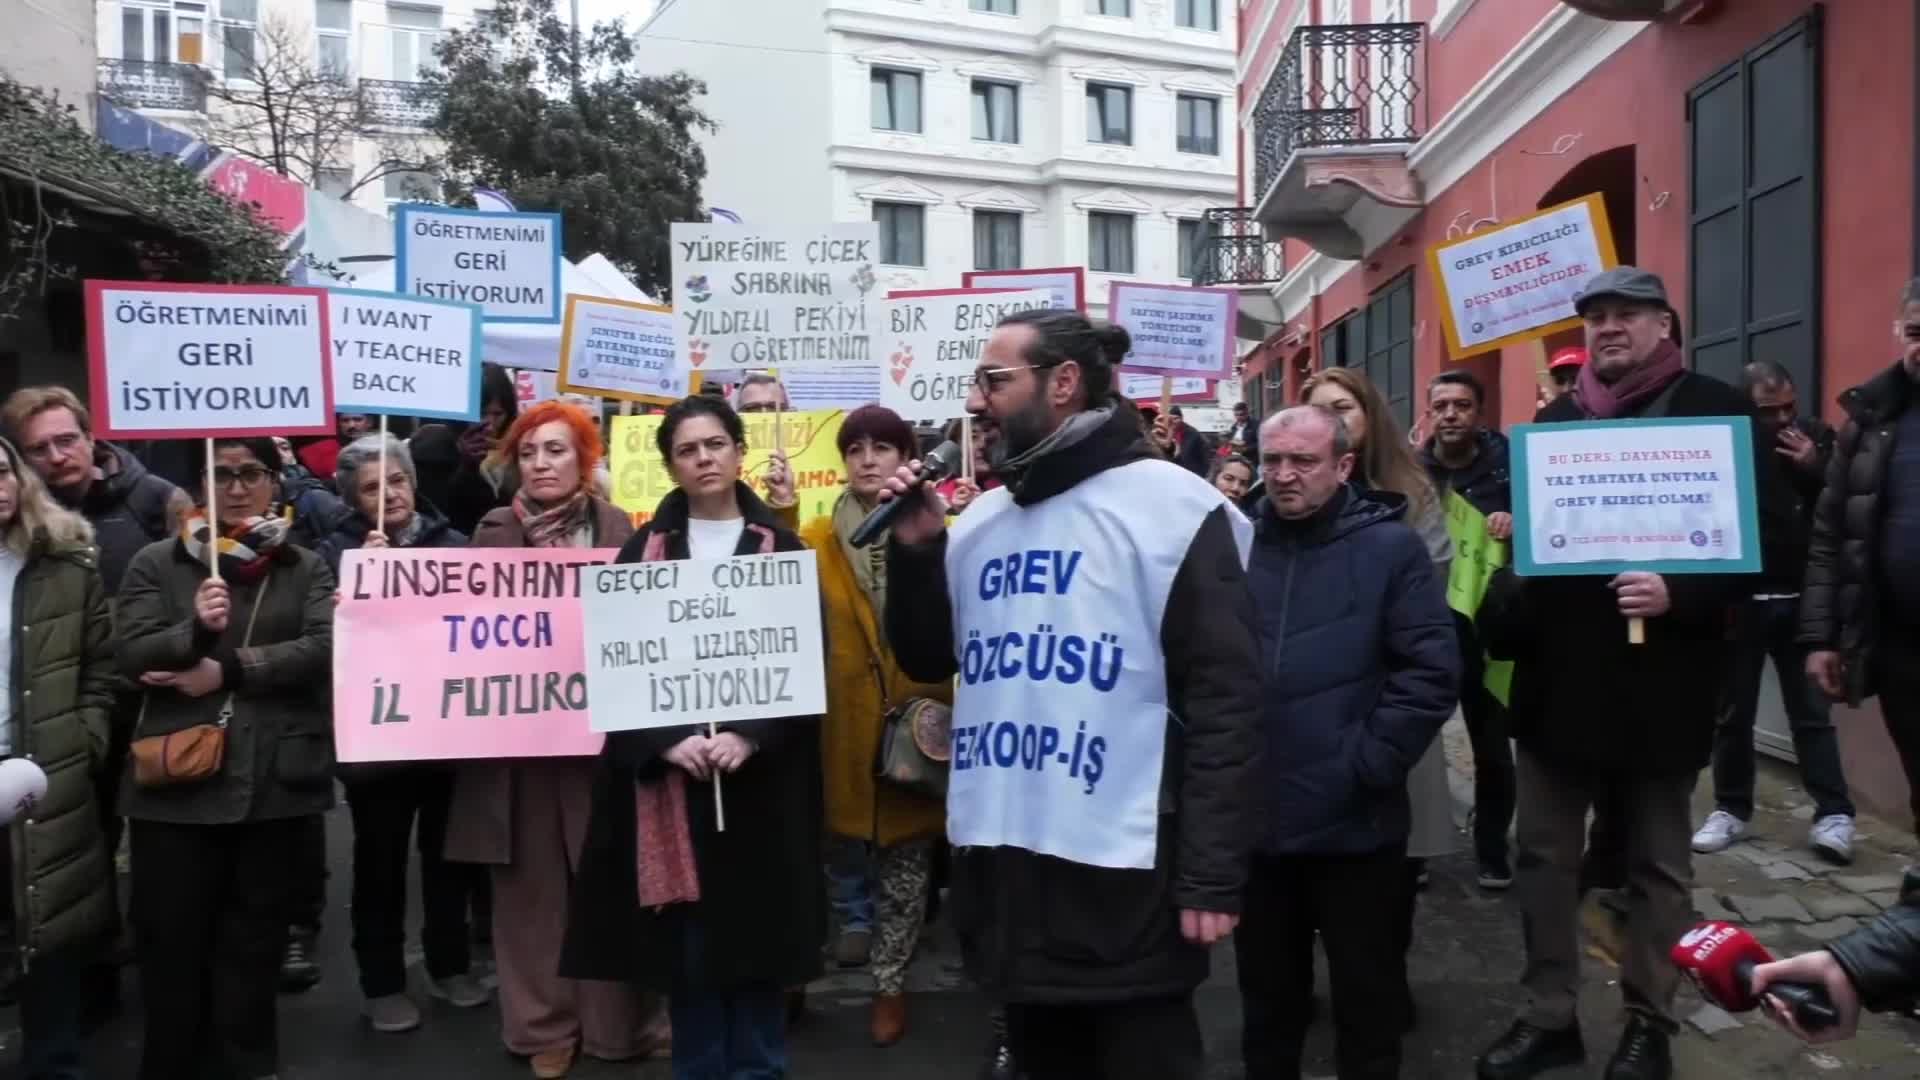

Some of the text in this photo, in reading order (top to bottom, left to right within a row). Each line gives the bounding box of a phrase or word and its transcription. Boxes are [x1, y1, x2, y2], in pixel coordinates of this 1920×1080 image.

[414, 219, 545, 243] ÖĞRETMENİMİ
[454, 249, 507, 271] GERİ
[1454, 250, 1495, 271] GREV
[1491, 250, 1552, 281] EMEK
[415, 278, 544, 305] İSTİYORUM
[731, 271, 832, 295] SABRINA
[115, 301, 307, 327] ÖĞRETMENİMİ
[343, 306, 433, 331] I WANT
[890, 304, 928, 334] BİR
[178, 337, 254, 366] GERİ
[333, 339, 463, 367] Y TEACHER
[121, 380, 310, 412] İSTİYORUM
[352, 372, 417, 394] BACK
[1548, 454, 1569, 465] BU
[1620, 449, 1713, 464] DAYANIŞMA
[1544, 471, 1720, 487] YAZ TAHTAYA UNUTMA
[1555, 496, 1597, 508] GREV
[1601, 494, 1654, 506] KIRICI
[353, 557, 604, 601] L'INSEGNANT
[595, 556, 803, 595] GEÇİCİ ÇÖZÜM
[978, 549, 1082, 601] GREV
[442, 611, 553, 653] TOCCA
[600, 626, 798, 669] KALICI UZLAŞMA
[960, 624, 1124, 692] ÖZCÜSÜ
[440, 671, 588, 719] FUTURO
[649, 666, 794, 713] İSTİYORUZ
